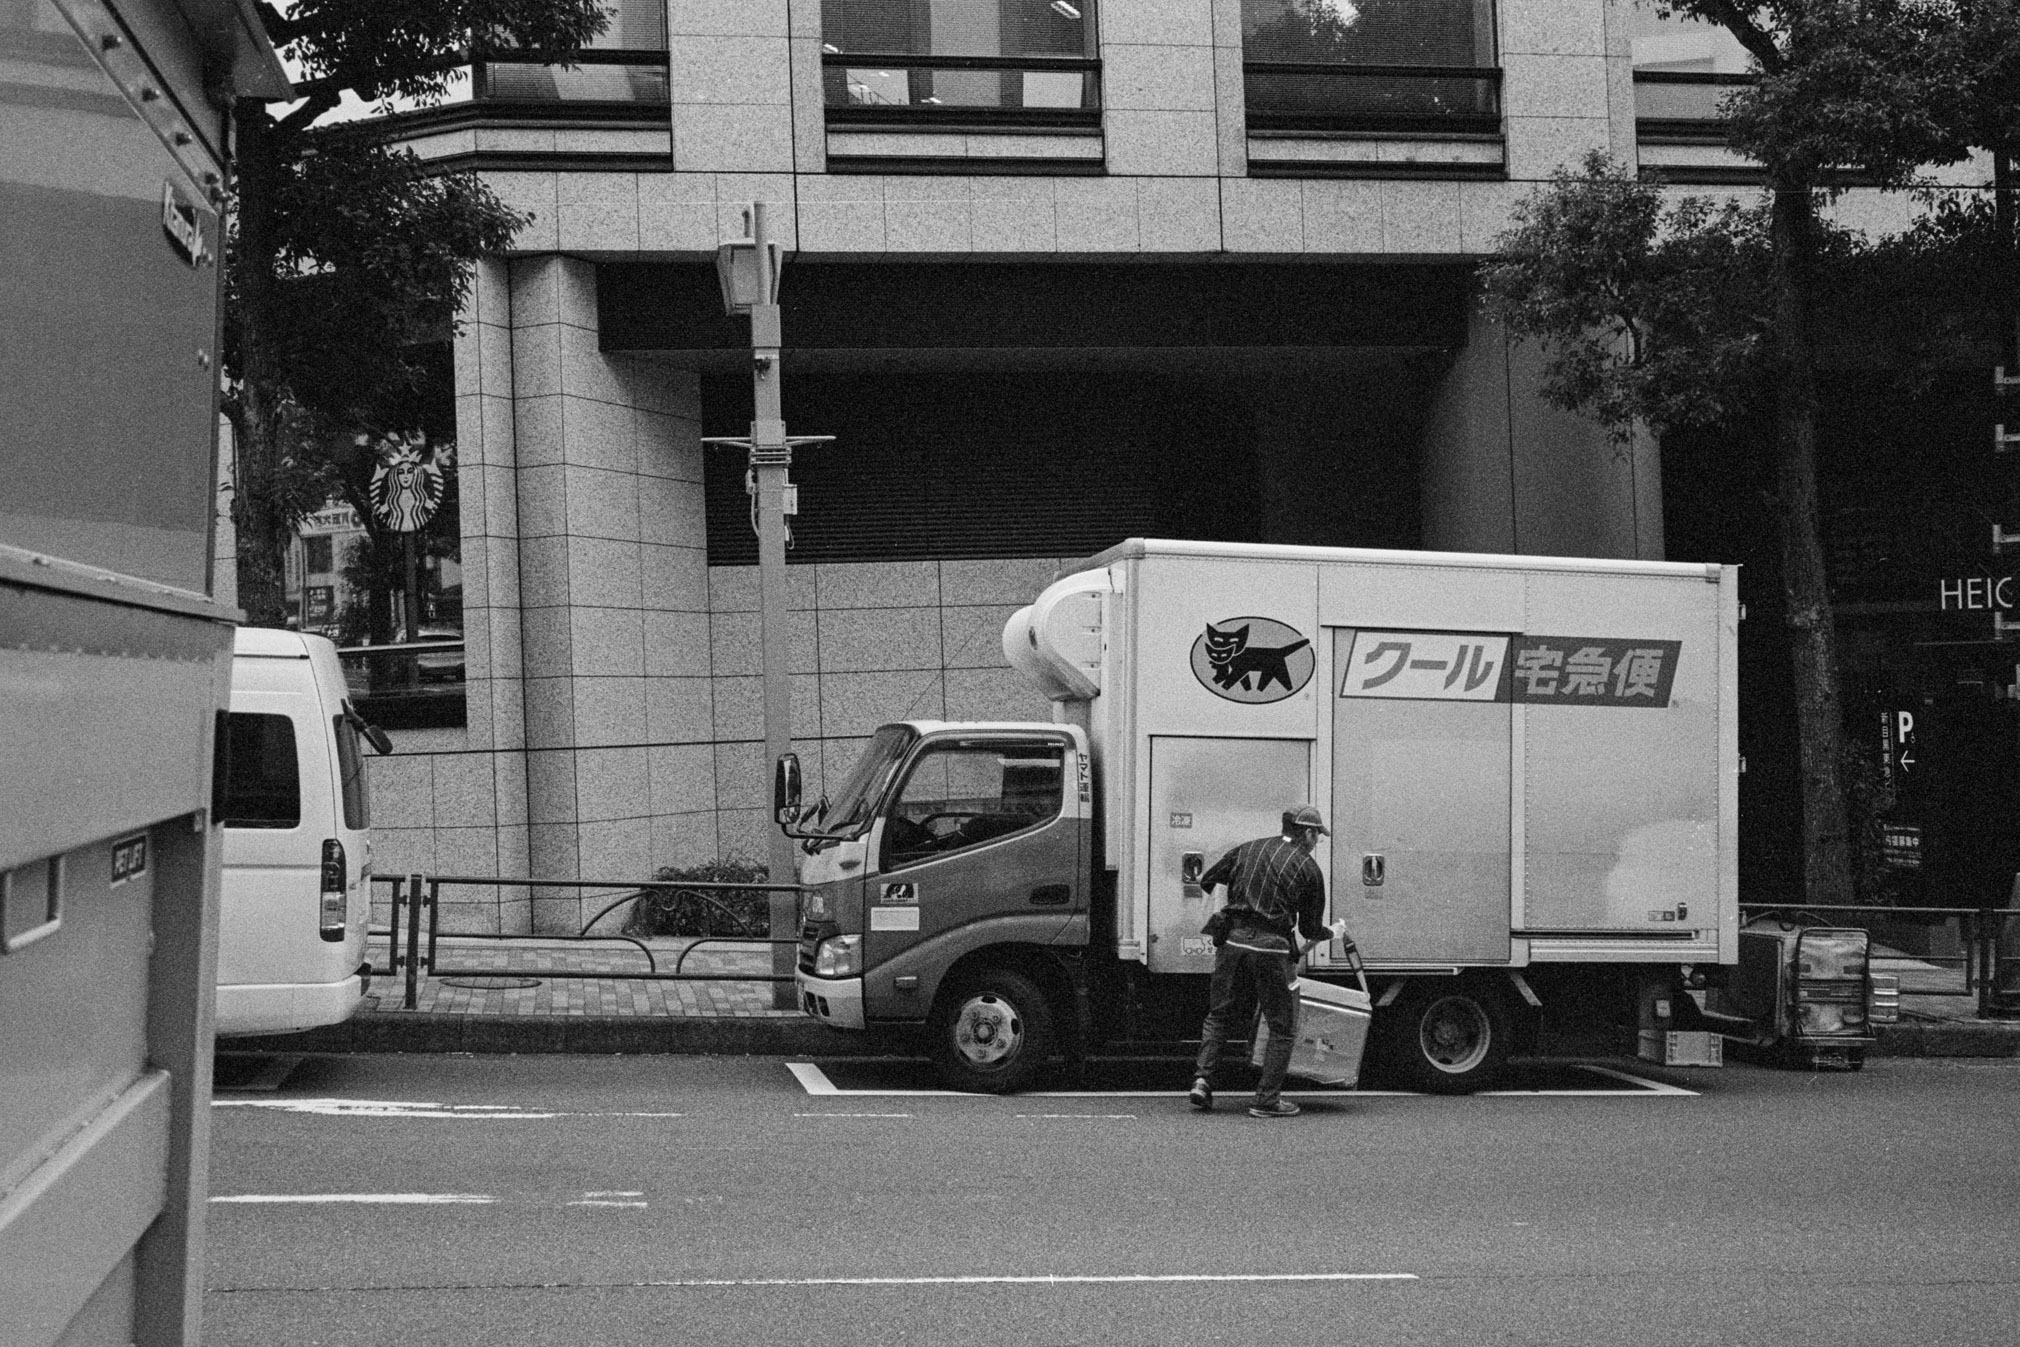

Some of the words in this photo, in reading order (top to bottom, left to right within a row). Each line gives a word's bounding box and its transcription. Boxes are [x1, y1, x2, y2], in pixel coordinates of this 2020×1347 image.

[1941, 577, 2013, 610] HEIC
[1361, 641, 1495, 692] クール
[1514, 644, 1665, 698] 宅急便
[1898, 711, 1914, 743] P
